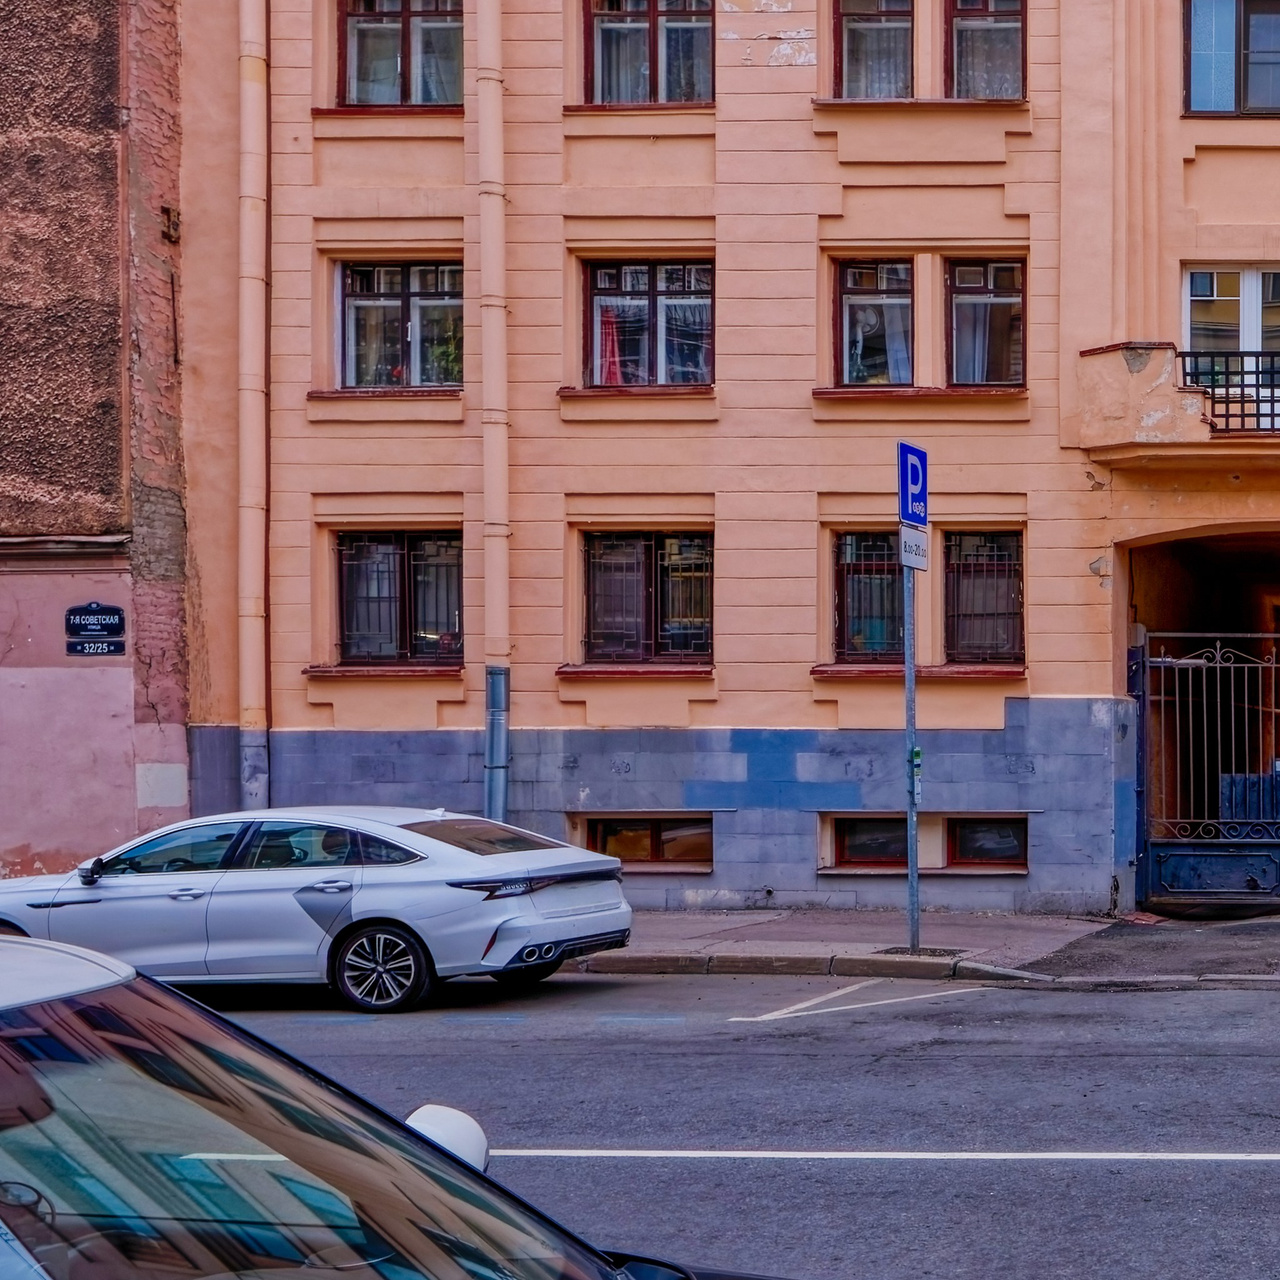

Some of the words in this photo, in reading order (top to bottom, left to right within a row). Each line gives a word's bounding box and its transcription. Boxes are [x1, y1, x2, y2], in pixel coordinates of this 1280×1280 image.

[908, 453, 922, 514] P
[80, 615, 119, 624] СОВЕТСКАЯ
[84, 643, 108, 653] 32/25
